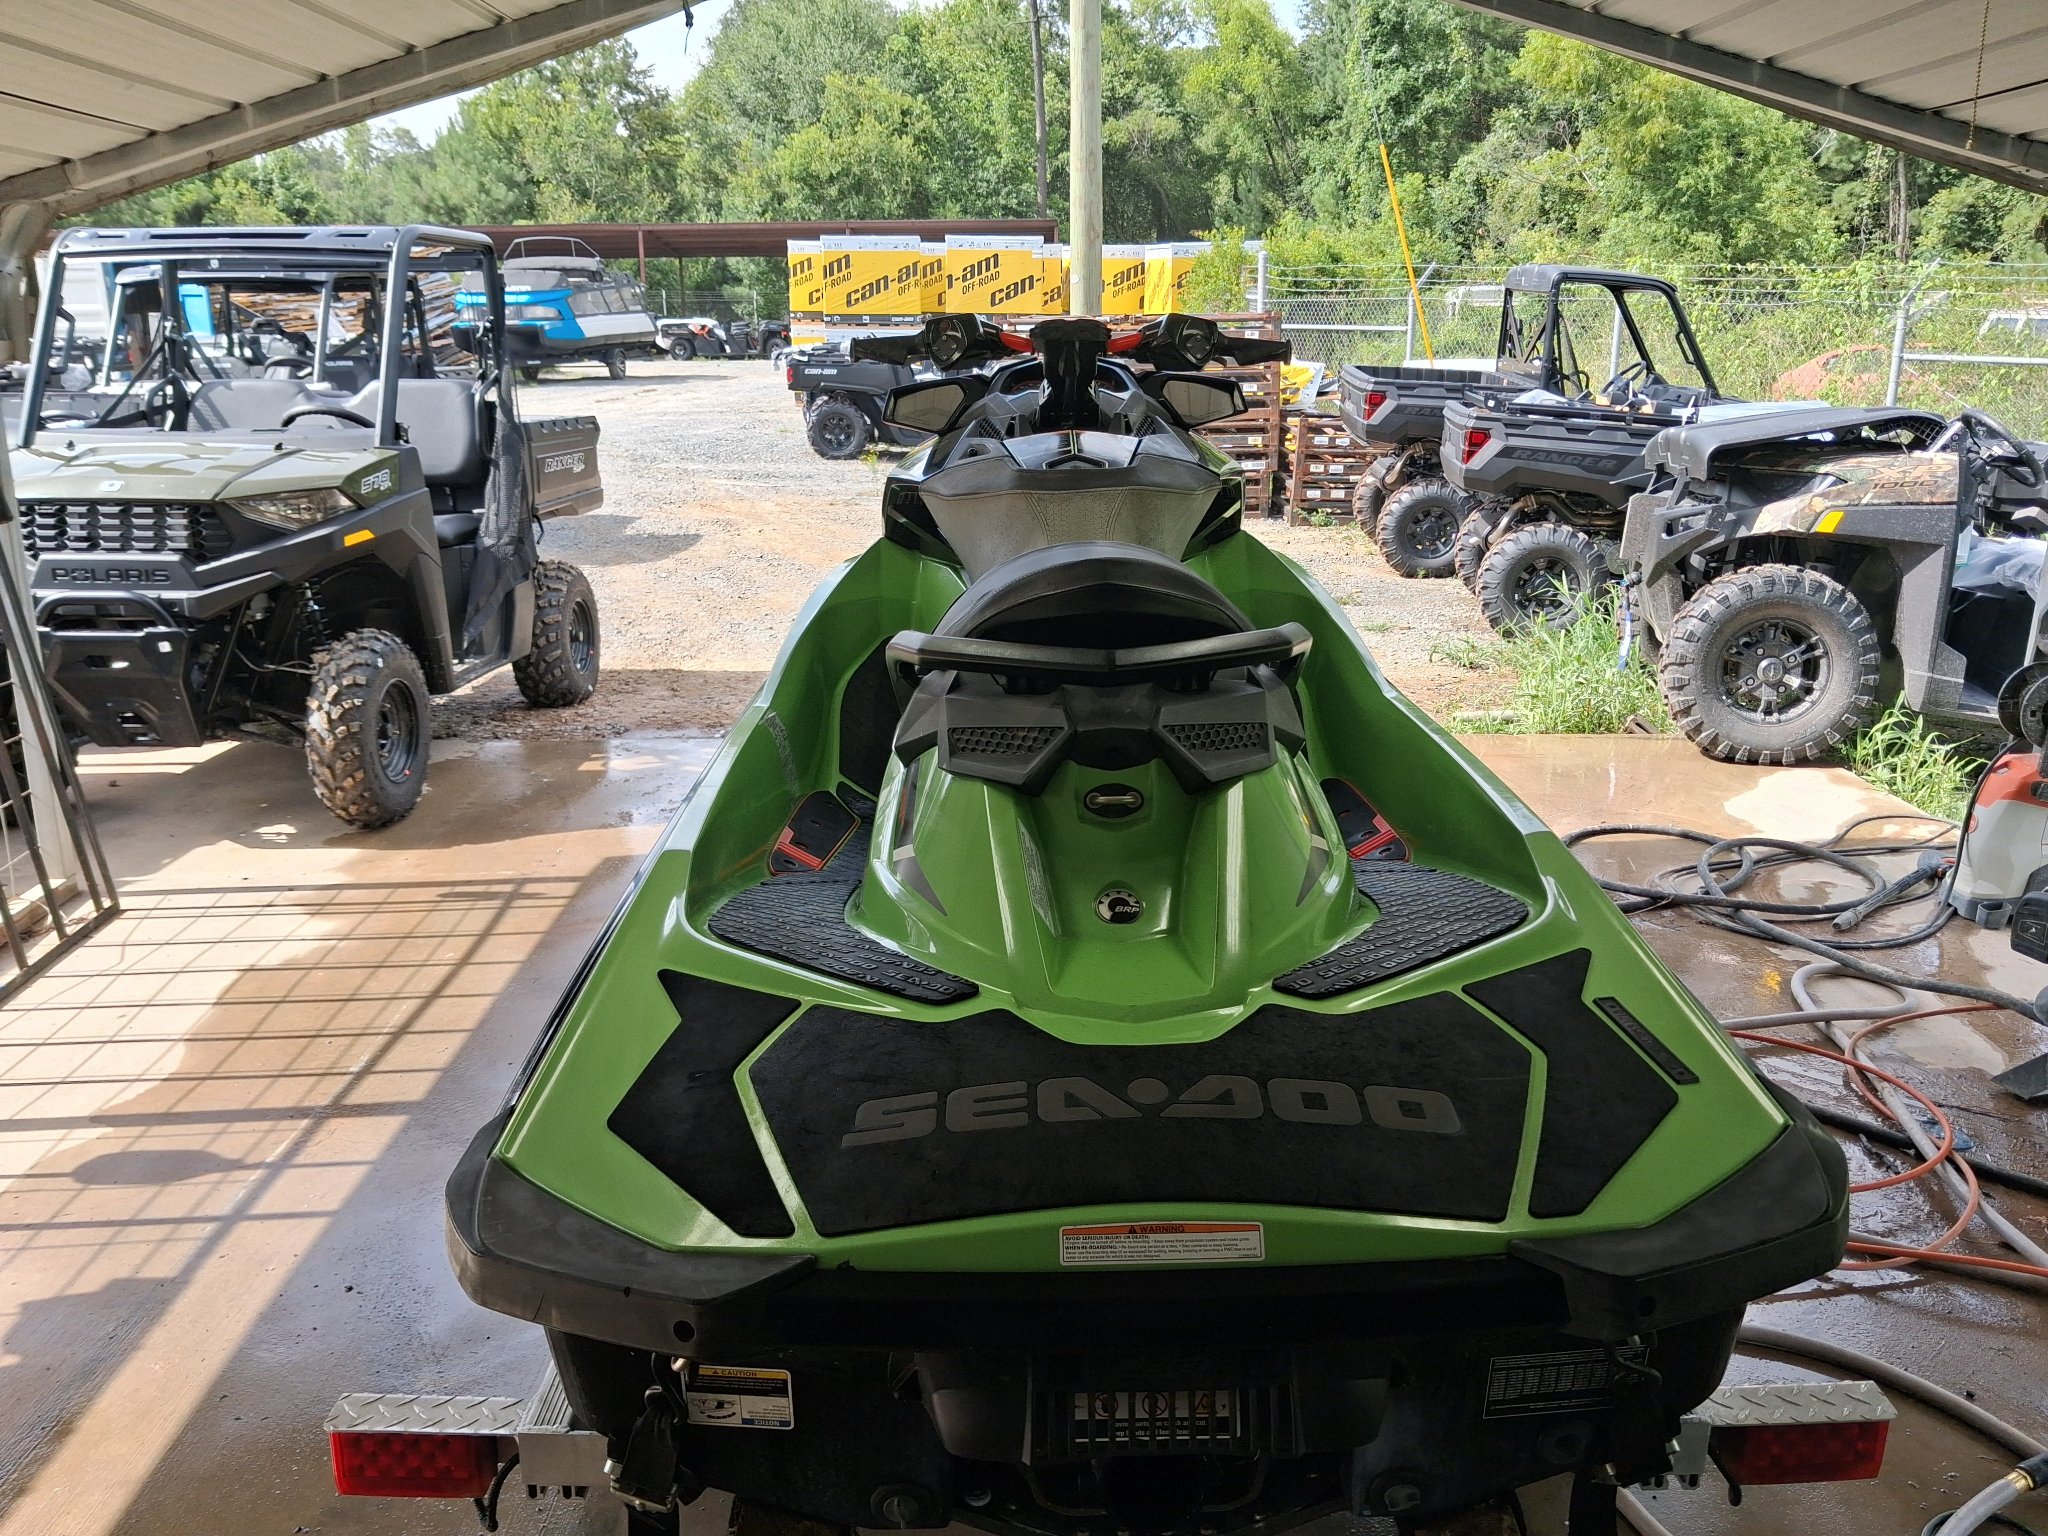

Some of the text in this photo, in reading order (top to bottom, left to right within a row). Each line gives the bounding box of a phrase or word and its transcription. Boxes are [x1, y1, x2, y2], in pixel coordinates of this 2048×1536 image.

[544, 453, 585, 473] RANGER
[1511, 448, 1618, 470] RANGER
[1867, 464, 1955, 480] XP
[1871, 480, 1940, 490] 1000
[51, 568, 171, 584] POLARIS
[1114, 905, 1140, 913] BRP
[1139, 1225, 1185, 1233] WARNING
[753, 1419, 780, 1427] NOTICE
